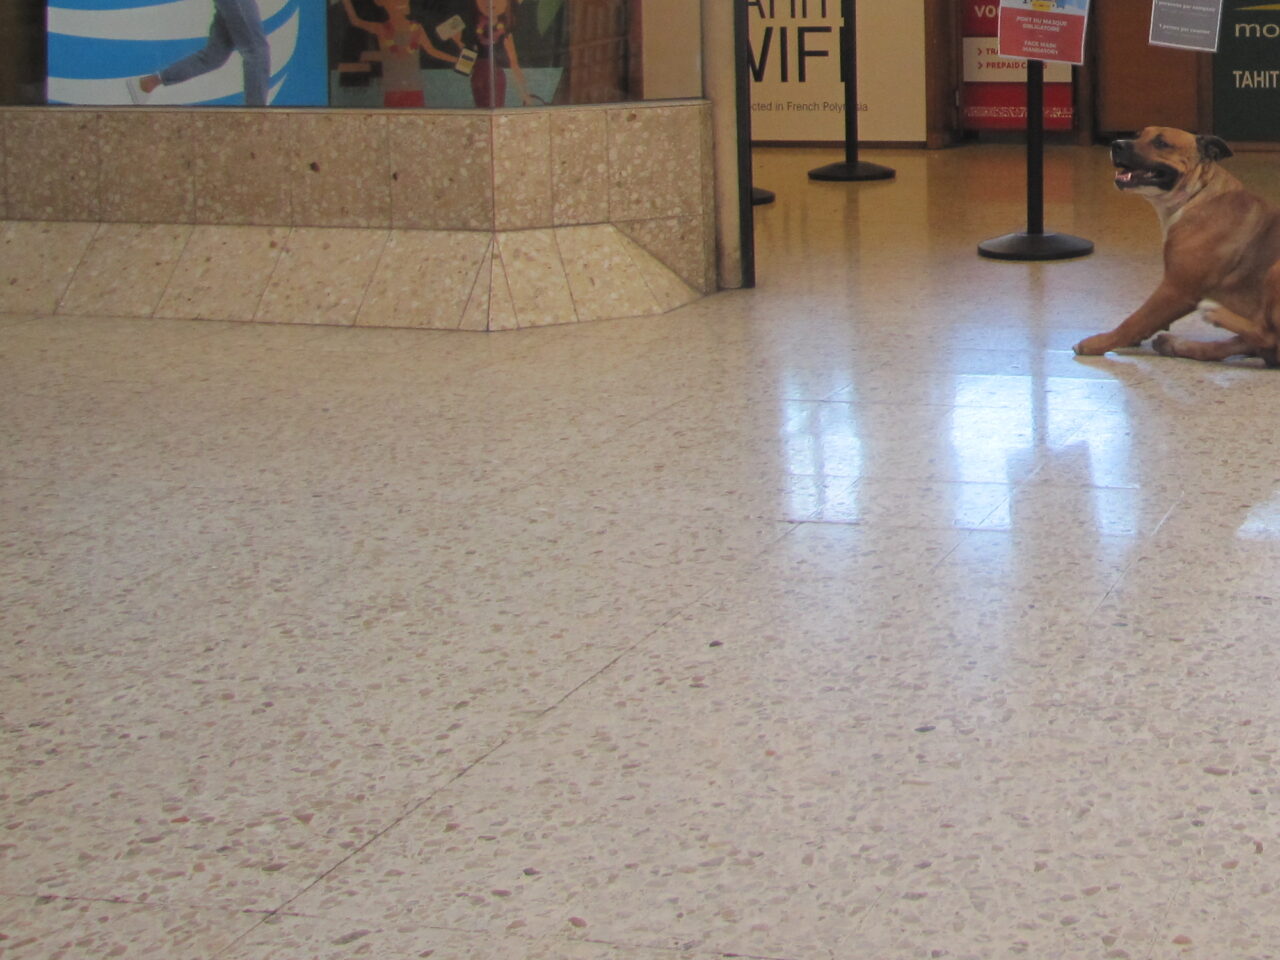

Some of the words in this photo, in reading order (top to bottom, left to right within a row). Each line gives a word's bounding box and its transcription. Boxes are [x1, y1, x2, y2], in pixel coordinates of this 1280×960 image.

[985, 61, 1020, 70] PREPAID
[775, 101, 784, 111] in
[786, 100, 820, 112] French
